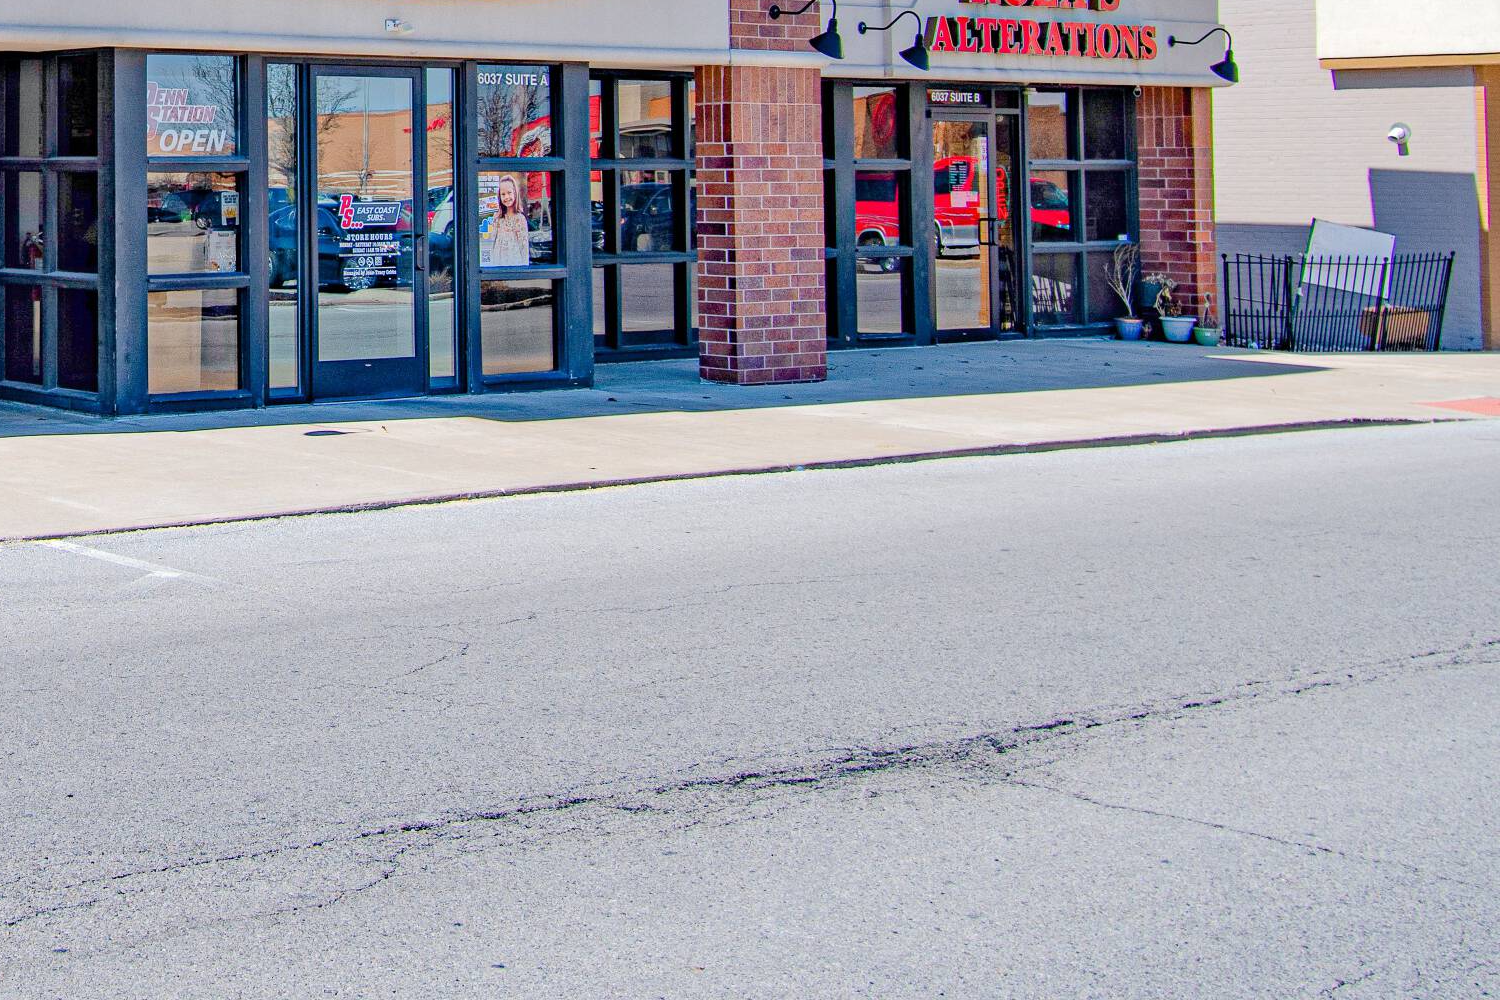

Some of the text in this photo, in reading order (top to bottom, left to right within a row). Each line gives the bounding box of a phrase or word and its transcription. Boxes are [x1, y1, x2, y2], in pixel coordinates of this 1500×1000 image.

[928, 15, 1158, 60] ALTERATIONS
[477, 72, 549, 86] 6037 SUITE A
[931, 91, 981, 103] 6037 SUITE B
[160, 129, 227, 152] OPEN
[357, 206, 396, 214] EAST COAST
[346, 233, 393, 241] STORE HOURS
